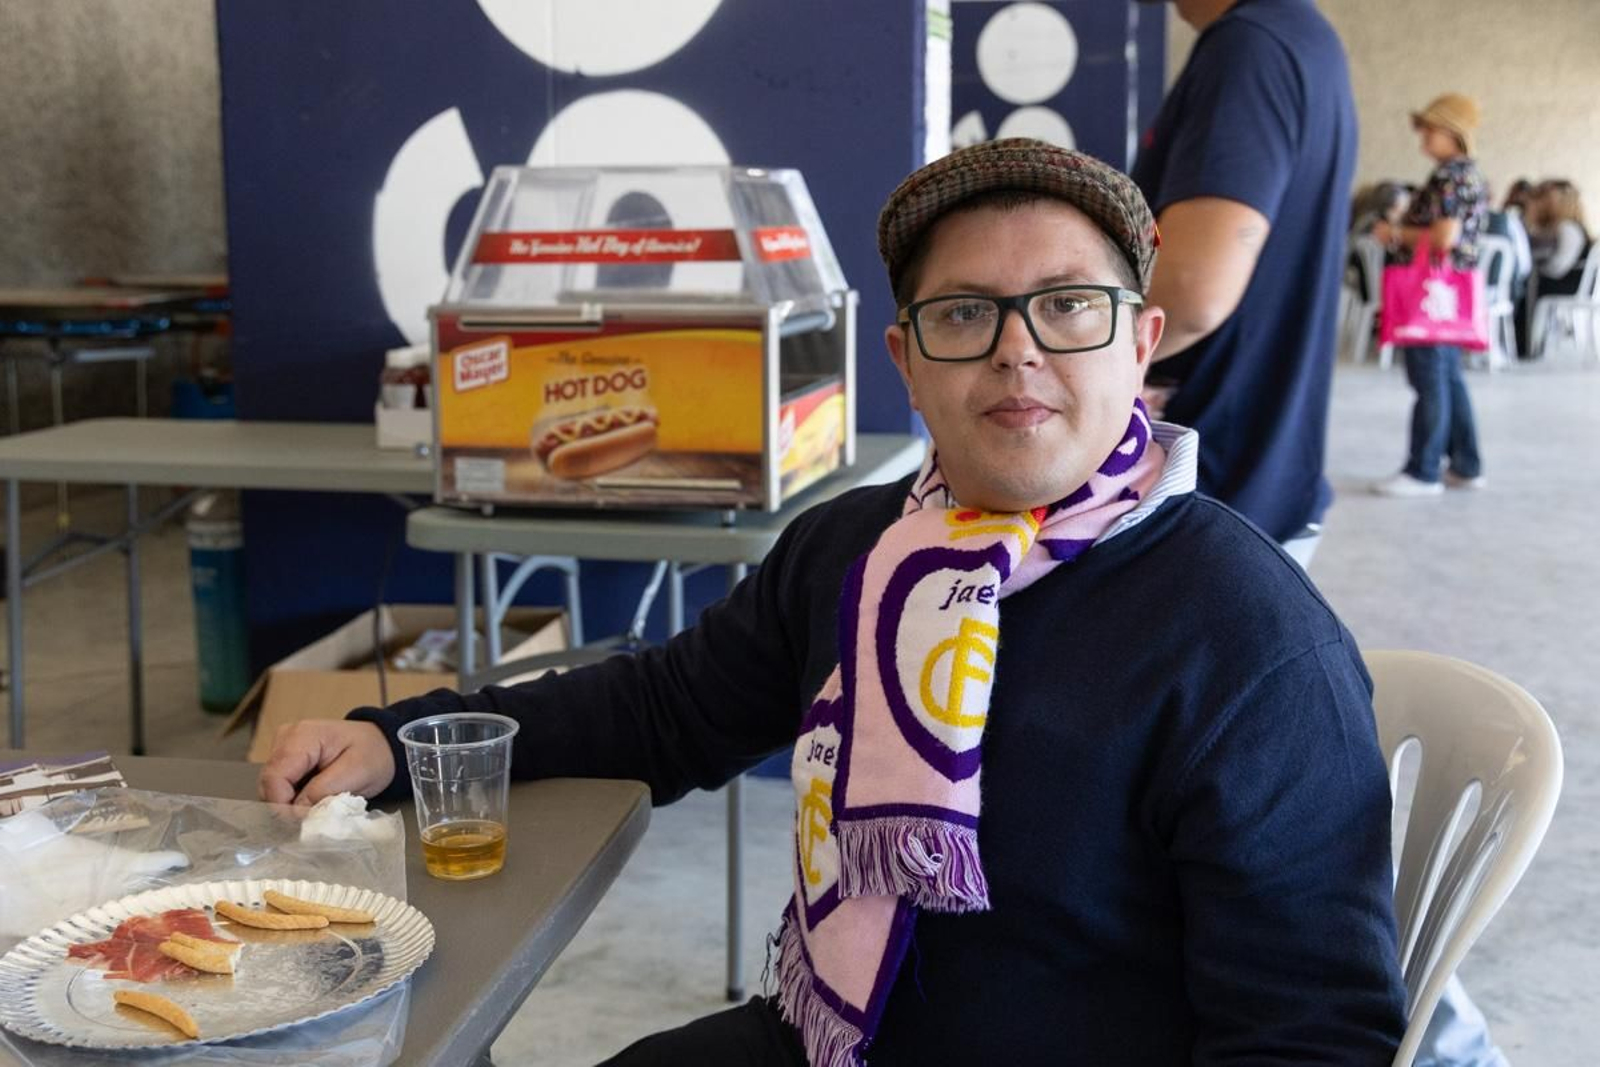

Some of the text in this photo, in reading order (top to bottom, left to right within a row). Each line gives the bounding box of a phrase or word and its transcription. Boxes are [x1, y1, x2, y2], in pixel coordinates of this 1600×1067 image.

[460, 349, 501, 368] Oscar
[460, 363, 504, 385] Mayer
[545, 368, 646, 404] HOT DOG
